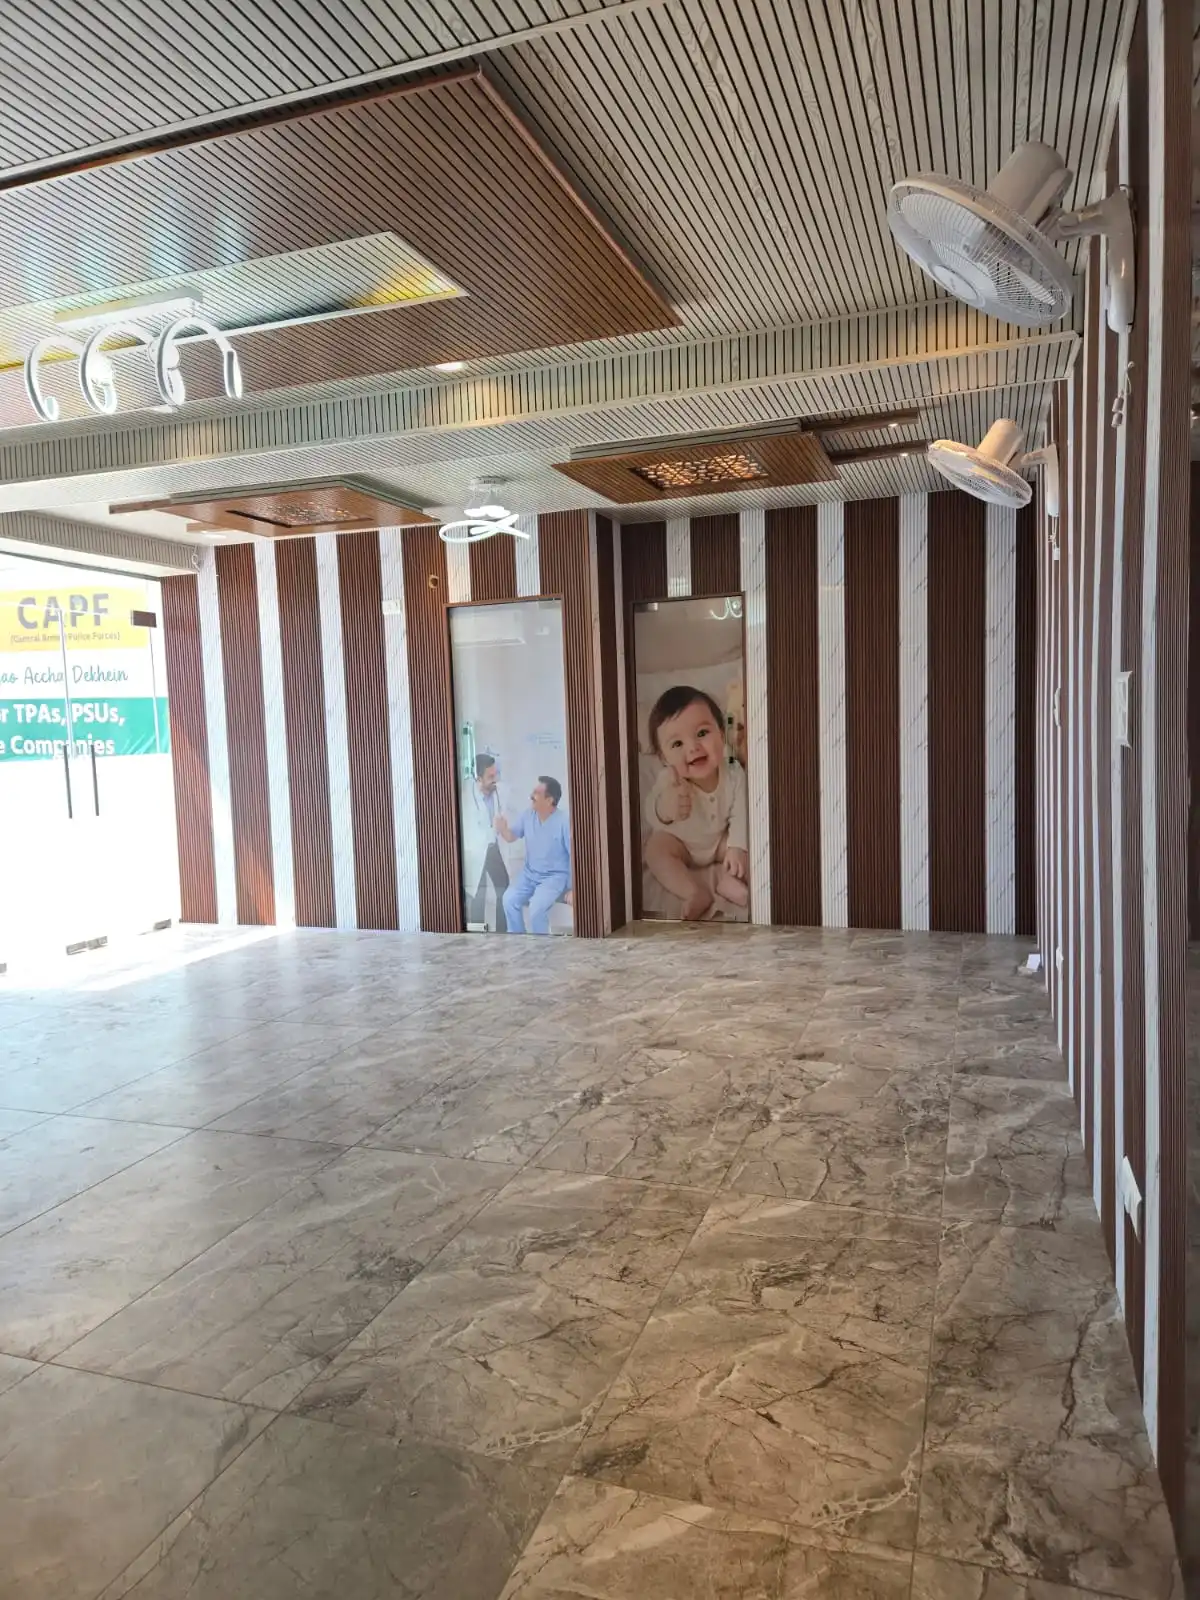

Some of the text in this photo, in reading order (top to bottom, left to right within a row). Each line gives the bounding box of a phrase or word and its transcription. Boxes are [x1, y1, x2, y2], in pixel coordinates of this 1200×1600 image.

[18, 593, 109, 629] CAPF
[42, 632, 66, 642] Arme
[24, 666, 64, 685] Accha
[72, 665, 129, 684] Dekhein
[13, 703, 66, 726] TPAs,
[72, 702, 125, 726] PSUs,
